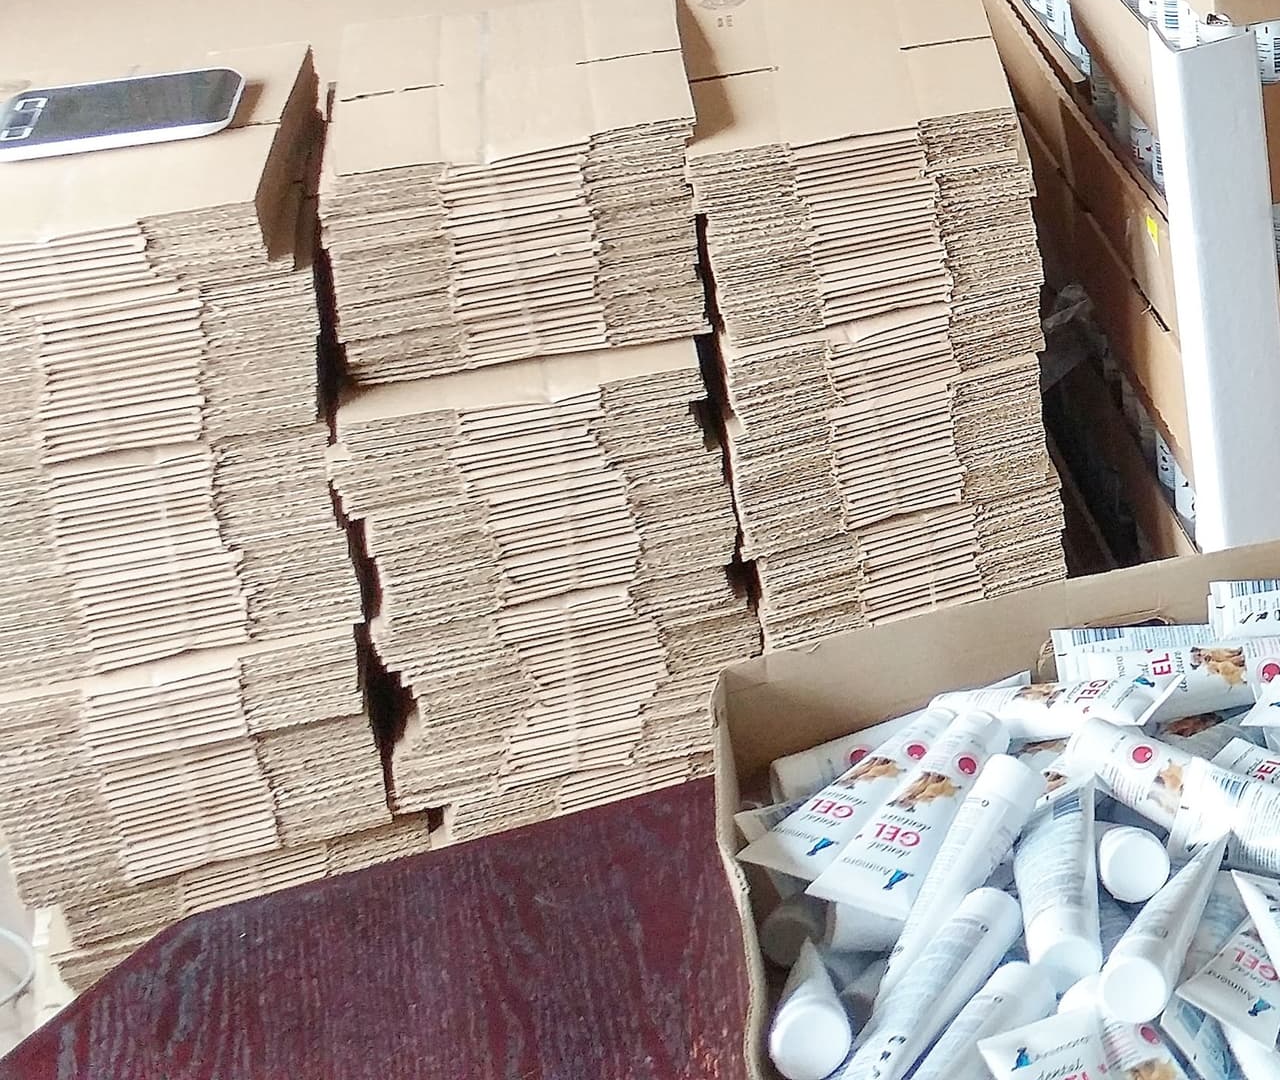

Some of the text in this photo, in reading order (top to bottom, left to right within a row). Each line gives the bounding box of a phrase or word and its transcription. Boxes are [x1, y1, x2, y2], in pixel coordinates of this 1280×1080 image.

[1151, 652, 1173, 676] EL
[1074, 679, 1108, 703] GEL
[810, 798, 854, 819] GEL
[875, 822, 921, 847] GEL
[1233, 947, 1280, 982] GEL
